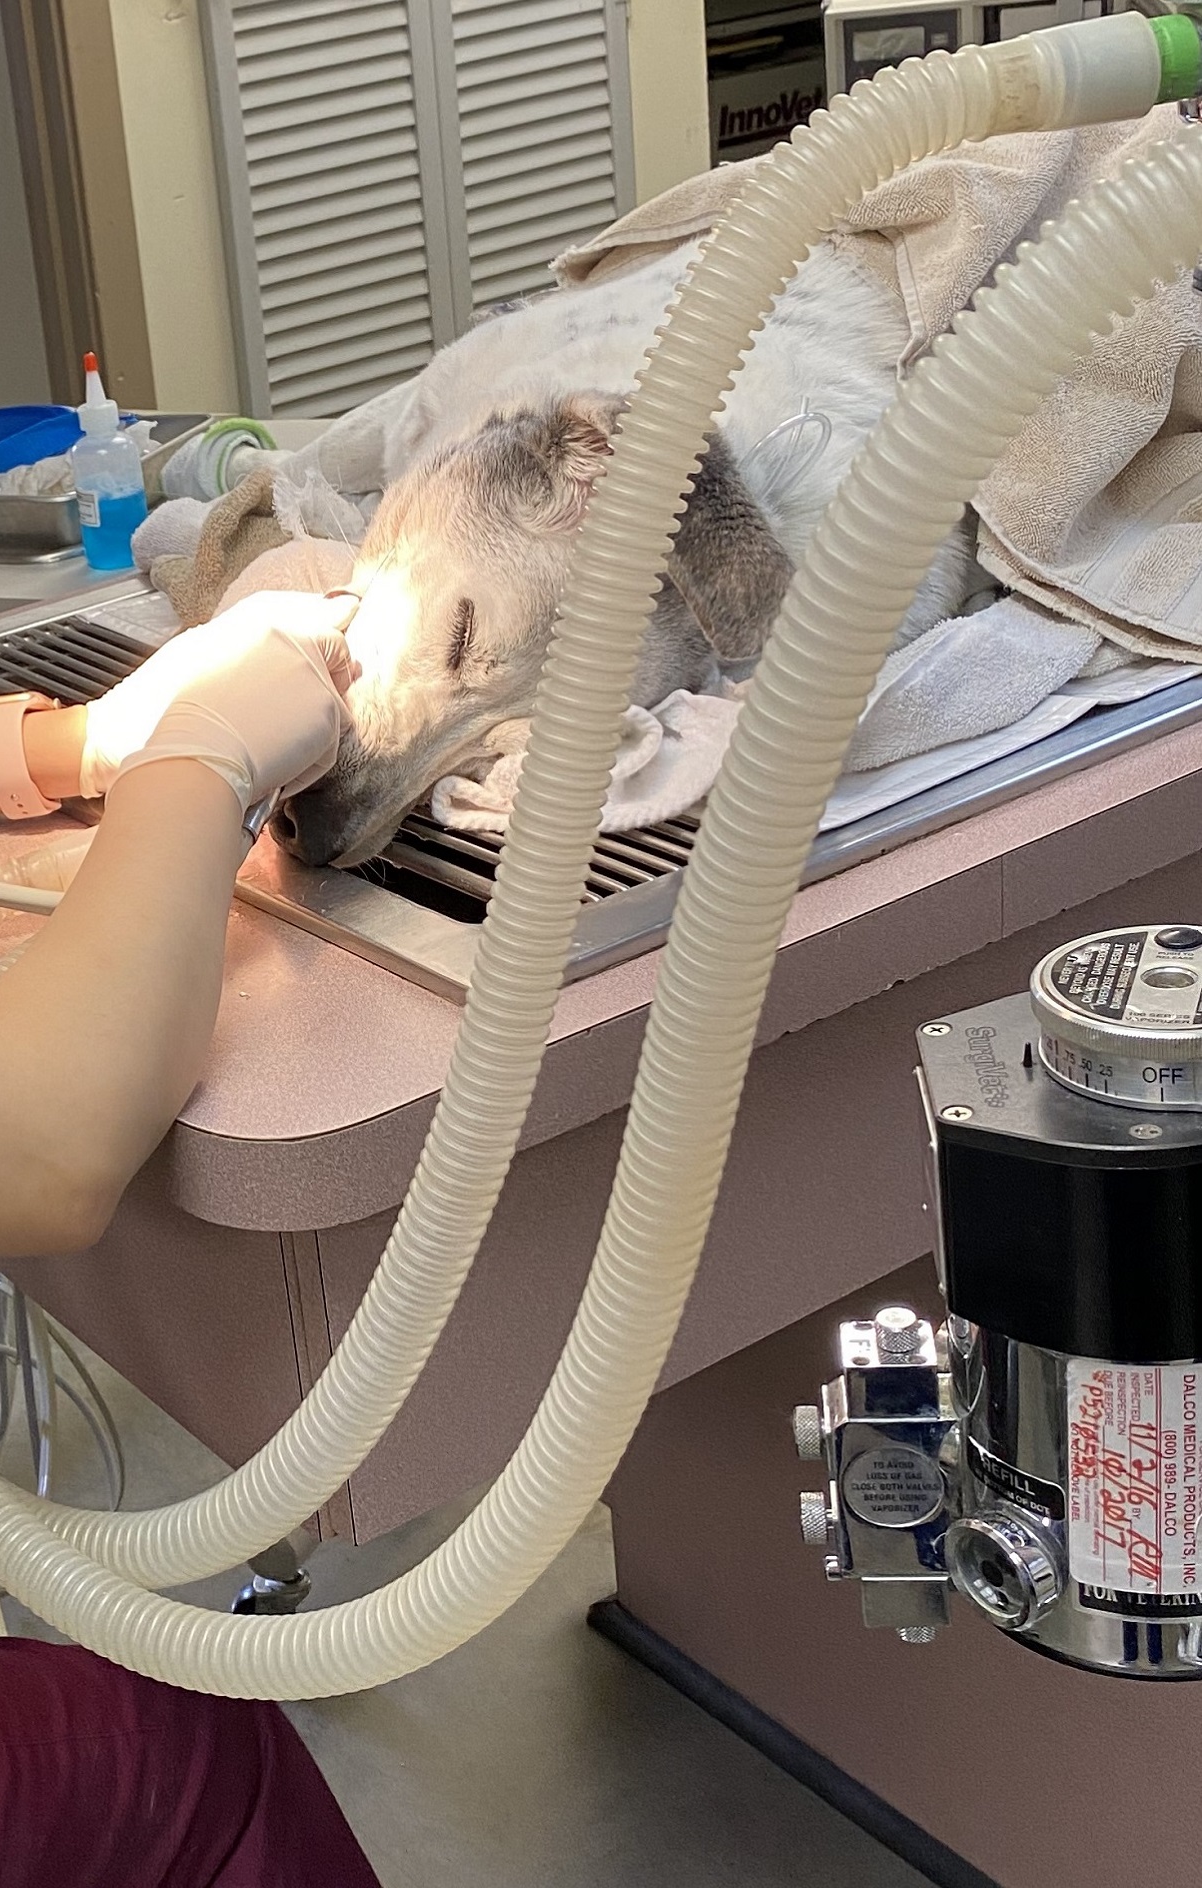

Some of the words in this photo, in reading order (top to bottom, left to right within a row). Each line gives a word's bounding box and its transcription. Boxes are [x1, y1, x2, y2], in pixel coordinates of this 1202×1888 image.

[719, 87, 823, 137] InnoVet
[1110, 943, 1124, 965] RESULT
[1142, 1066, 1184, 1084] OFF
[1130, 1372, 1141, 1421] INSPECTED
[1144, 1372, 1154, 1396] DATE
[1104, 1391, 1114, 1426] BEFORE
[1117, 1371, 1127, 1436] REINSPECTION
[1183, 1374, 1196, 1420] DALCO
[1163, 1430, 1177, 1459] (800)
[1183, 1425, 1196, 1482] MEDICAL
[866, 1472, 888, 1480] LOSS
[890, 1472, 901, 1480] OF
[904, 1472, 923, 1480] GAS
[873, 1461, 885, 1469] TO
[887, 1461, 915, 1469] AVOID
[851, 1482, 877, 1491] CLOSE
[879, 1482, 904, 1491] BOTH
[906, 1482, 940, 1491] VALVES
[863, 1493, 895, 1502] BEFORE
[899, 1493, 928, 1502] USING
[1071, 1497, 1081, 1522] LABEL
[1132, 1507, 1141, 1520] BY
[1164, 1492, 1177, 1537] DALCO
[1182, 1486, 1196, 1560] PRODUCTS,
[1183, 1563, 1196, 1588] INC.
